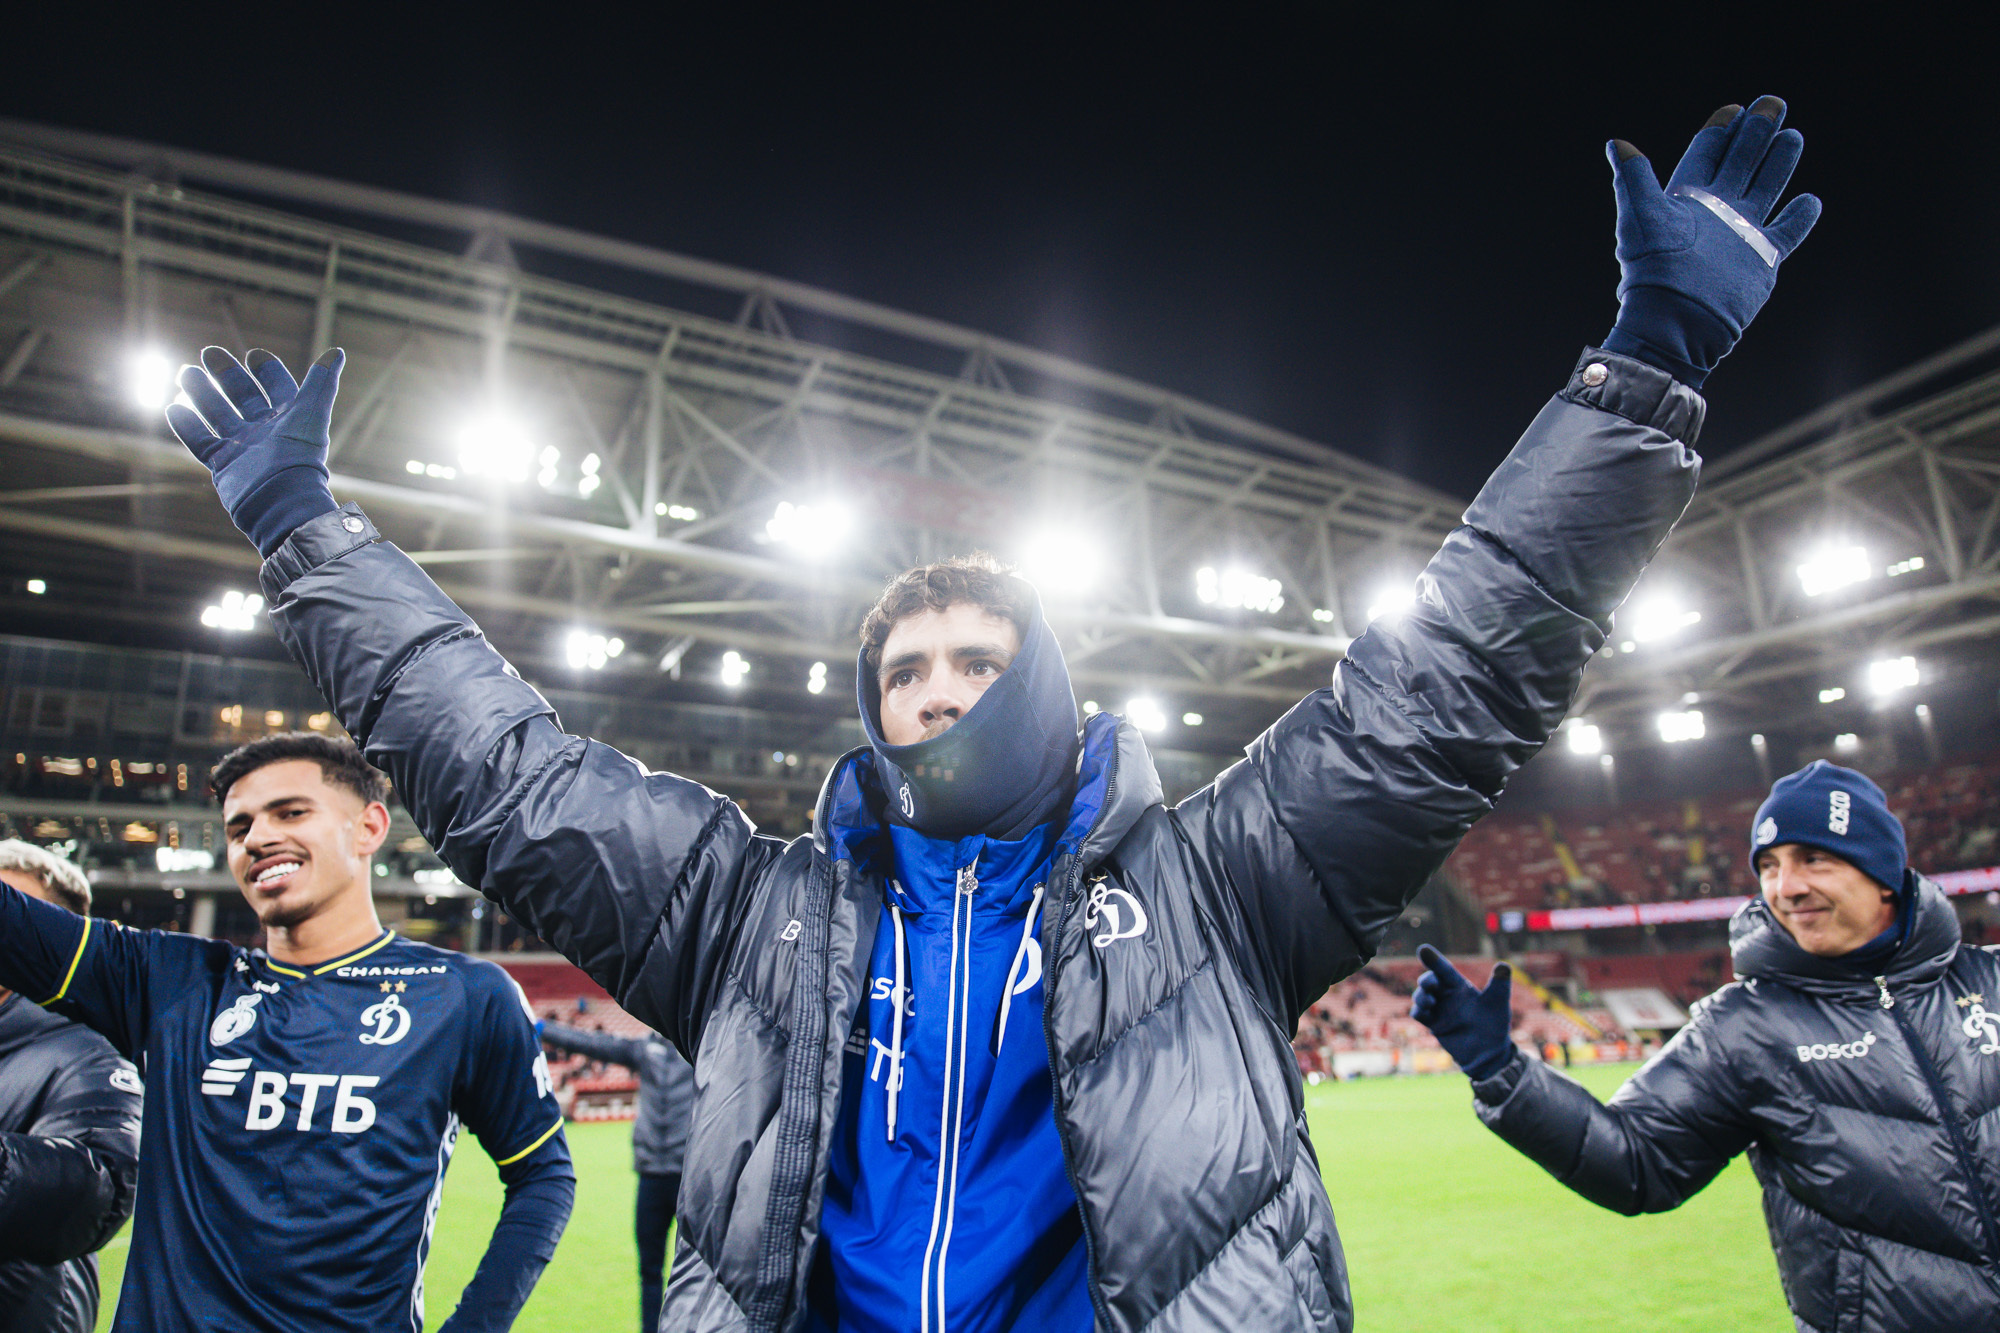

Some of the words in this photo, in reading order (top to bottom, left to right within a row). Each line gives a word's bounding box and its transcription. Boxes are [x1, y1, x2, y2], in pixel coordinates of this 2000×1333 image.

[336, 965, 447, 978] CHANGAN
[1796, 1040, 1869, 1063] BOSCO
[245, 1070, 381, 1134] ВТБ
